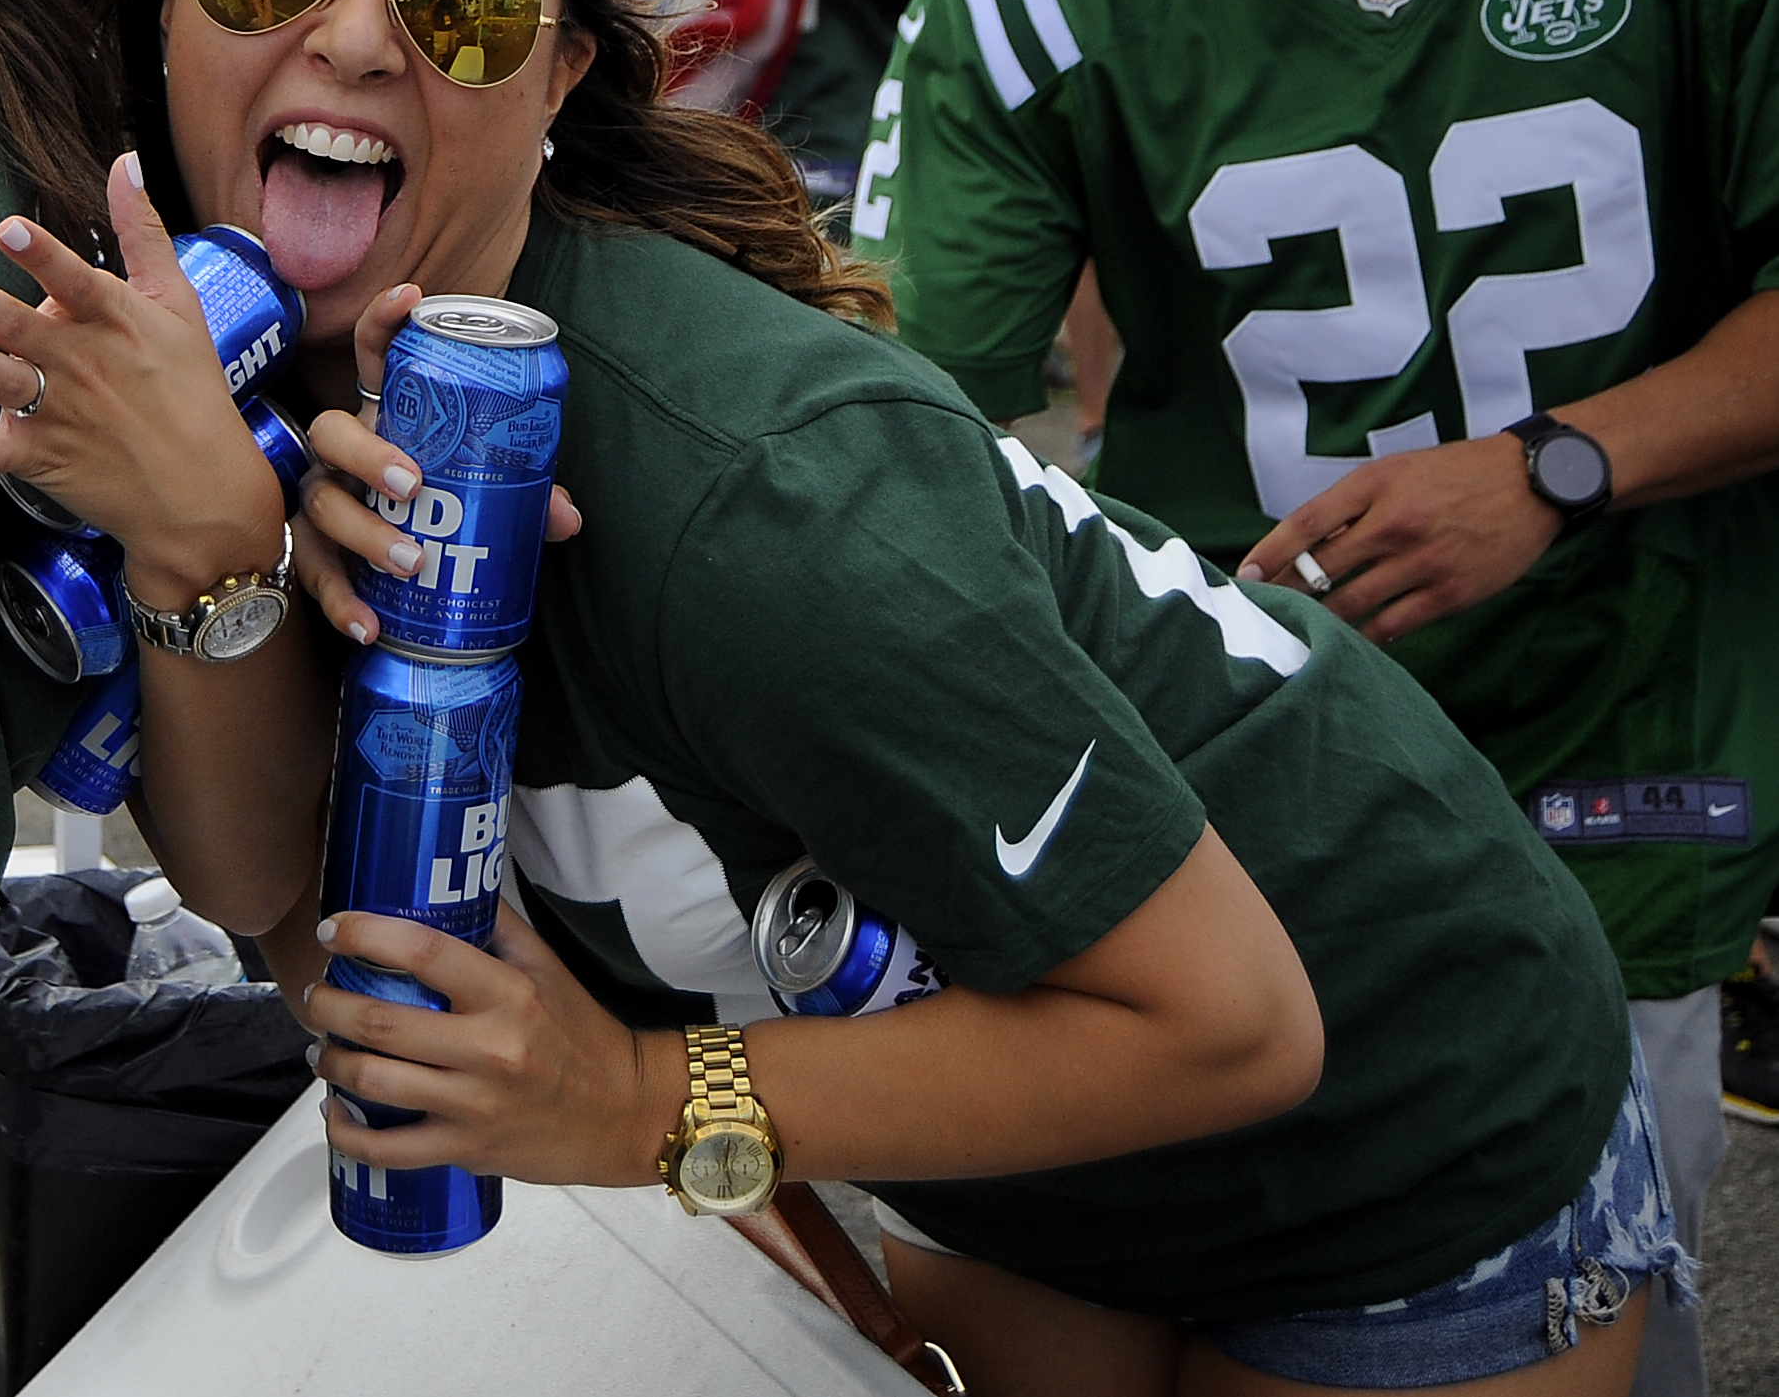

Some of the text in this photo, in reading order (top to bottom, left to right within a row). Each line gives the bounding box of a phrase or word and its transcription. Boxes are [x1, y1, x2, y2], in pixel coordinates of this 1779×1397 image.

[1188, 96, 1657, 521] 22
[443, 468, 505, 482] REGISTERED
[407, 589, 433, 604] THE
[437, 596, 502, 610] CHOICEST
[435, 610, 465, 622] AND
[468, 612, 500, 622] RICE
[396, 731, 433, 751] WORLD
[430, 785, 459, 795] TRADE
[395, 907, 447, 919] ALWAYS
